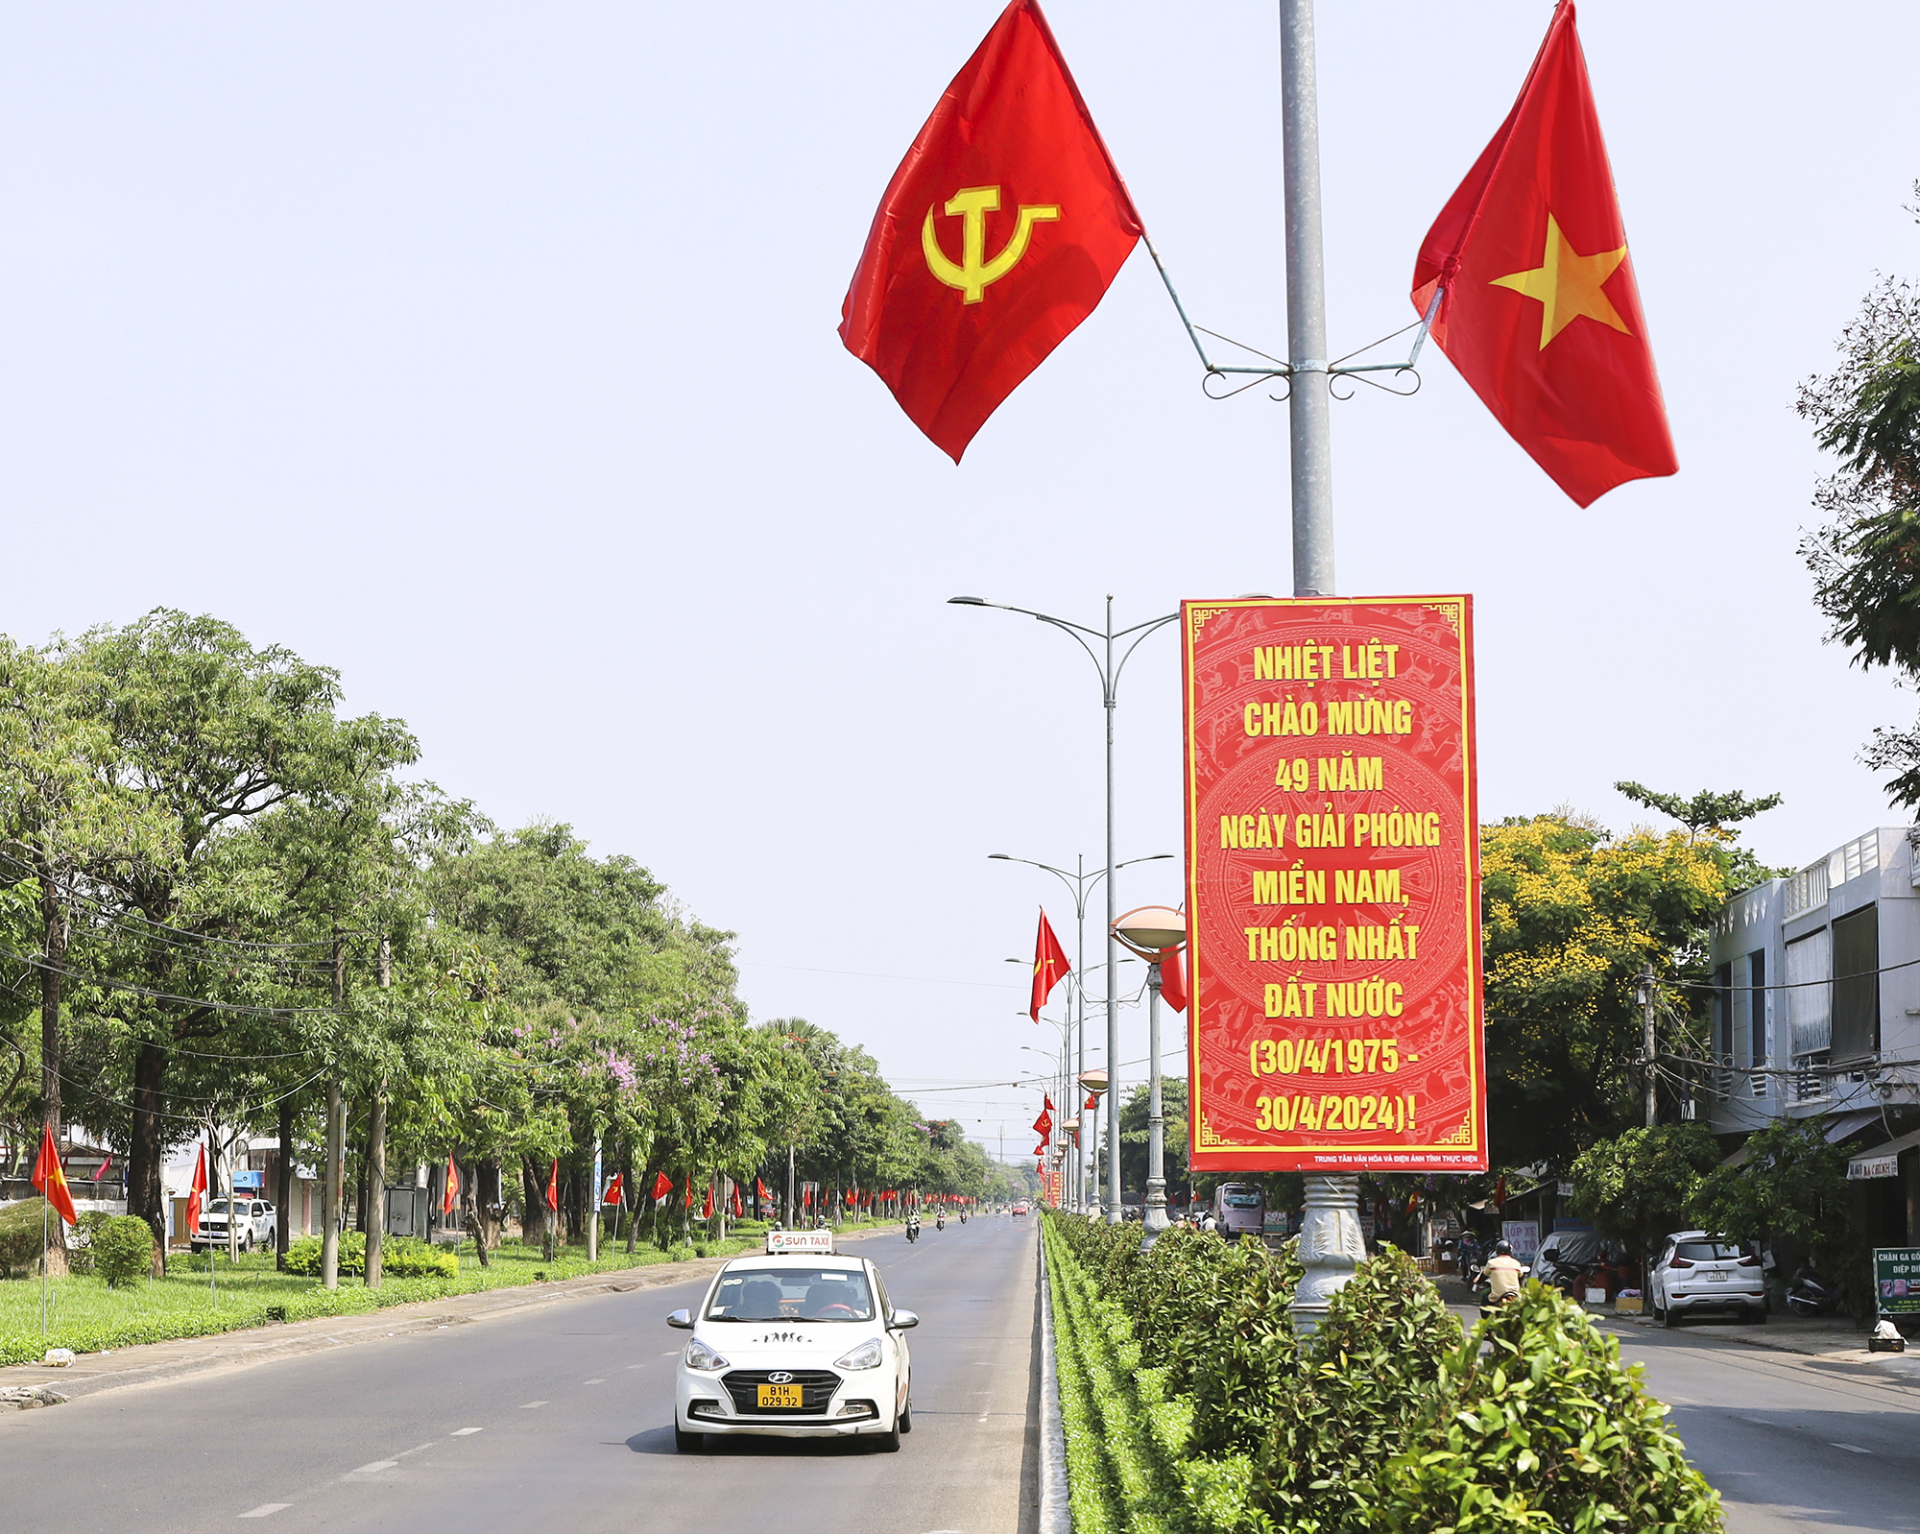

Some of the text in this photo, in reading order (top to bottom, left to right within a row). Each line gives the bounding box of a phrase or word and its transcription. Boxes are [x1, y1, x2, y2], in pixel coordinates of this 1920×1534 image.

[1254, 637, 1399, 688] NHIỆT LIỆT
[1244, 694, 1412, 737] CHÀO MỪNG
[1275, 750, 1384, 793] 49 NĂM
[1220, 802, 1440, 850] NGÀY GIẢI PHÓNG
[1253, 859, 1410, 909] MIỀN NAM,
[1244, 913, 1420, 962] THỐNG NHẤT
[1264, 970, 1404, 1019] ĐẤT NƯỚC
[1250, 1039, 1420, 1078] (30/4/1975 -
[1255, 1096, 1417, 1135] 30/4/2024)!
[1314, 1155, 1337, 1163] TRUNG
[1338, 1154, 1353, 1163] TÂM
[1368, 1154, 1383, 1163] HÓA
[1383, 1154, 1393, 1163] VÀ
[1394, 1154, 1410, 1164] ĐIỆN
[1442, 1155, 1461, 1164] THỰC
[1461, 1154, 1478, 1164] HIỆN
[810, 1236, 829, 1246] TAXI
[1524, 1226, 1536, 1237] XE
[1899, 1253, 1910, 1261] GA
[1911, 1265, 1920, 1273] DI
[762, 1396, 798, 1407] 029.32
[770, 1386, 790, 1396] 81H
